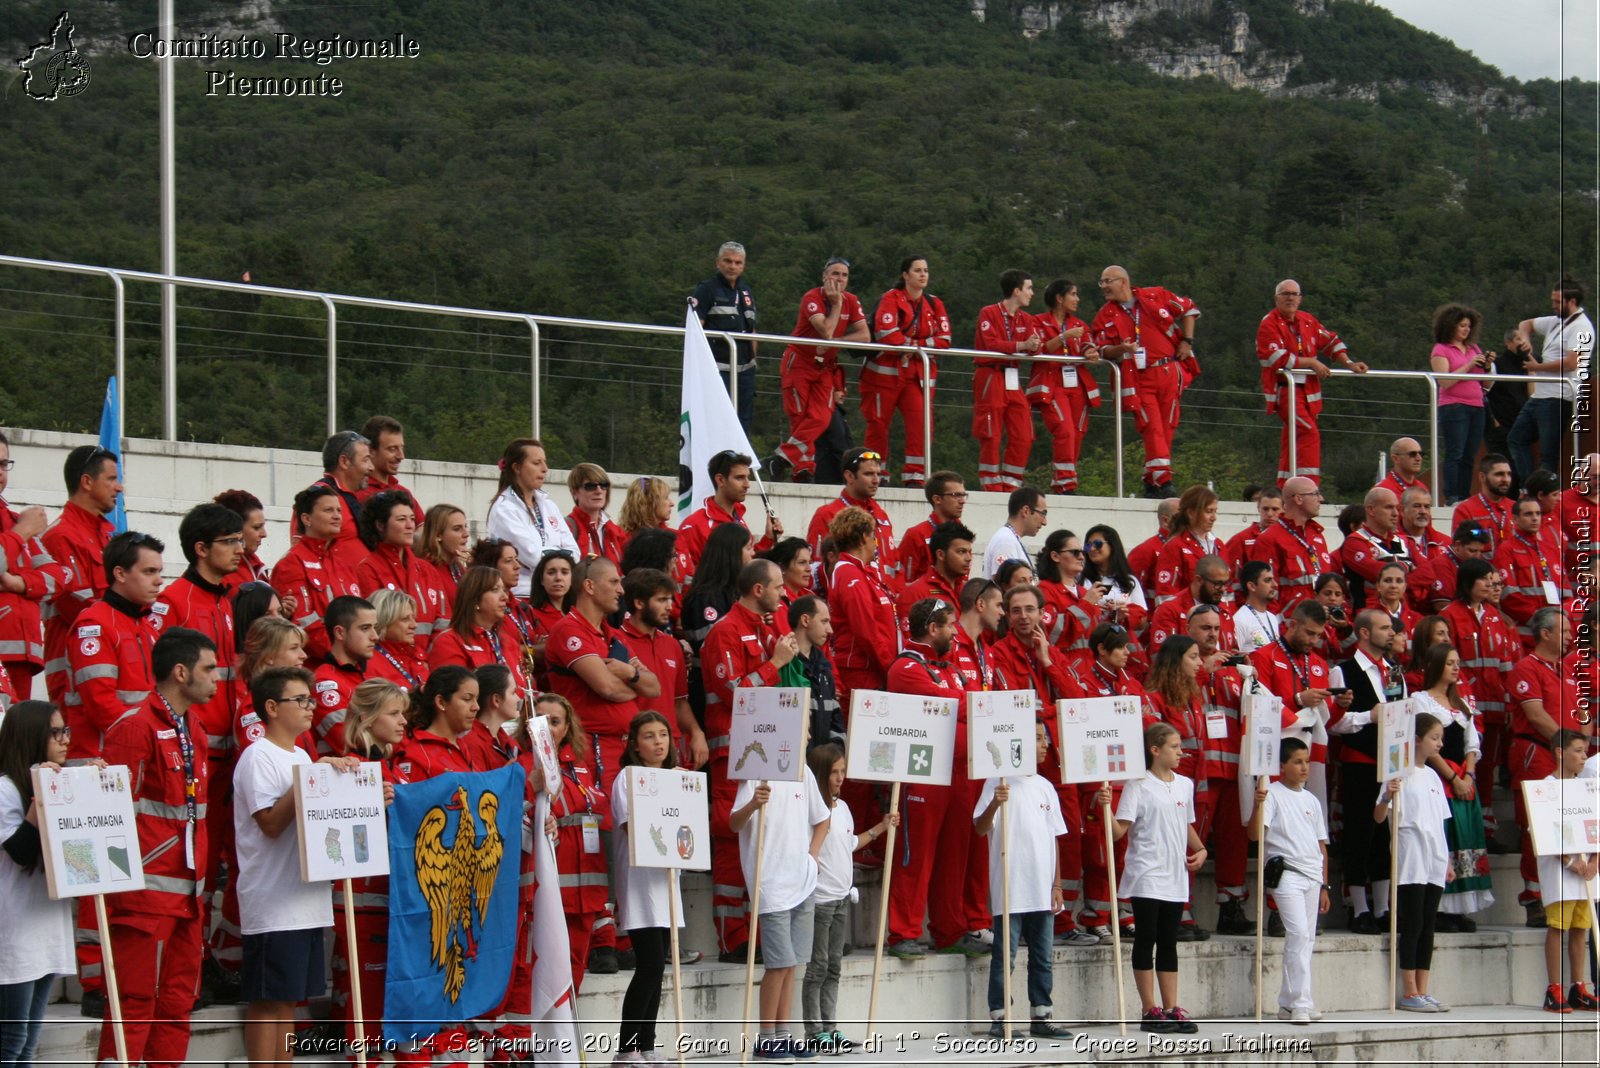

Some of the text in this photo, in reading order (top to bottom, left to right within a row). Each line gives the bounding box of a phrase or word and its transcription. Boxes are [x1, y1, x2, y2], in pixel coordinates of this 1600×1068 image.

[753, 724, 776, 733] LIGURIA
[879, 726, 927, 738] LOMBARDIA
[993, 724, 1014, 733] MARCHE
[1086, 730, 1119, 738] PIEMONTE
[307, 806, 380, 821] FRIULI-VENEZIA GIULIA
[661, 807, 680, 817] LAZIO
[58, 817, 83, 830] EMILIA
[87, 815, 124, 828] ROMAGNA
